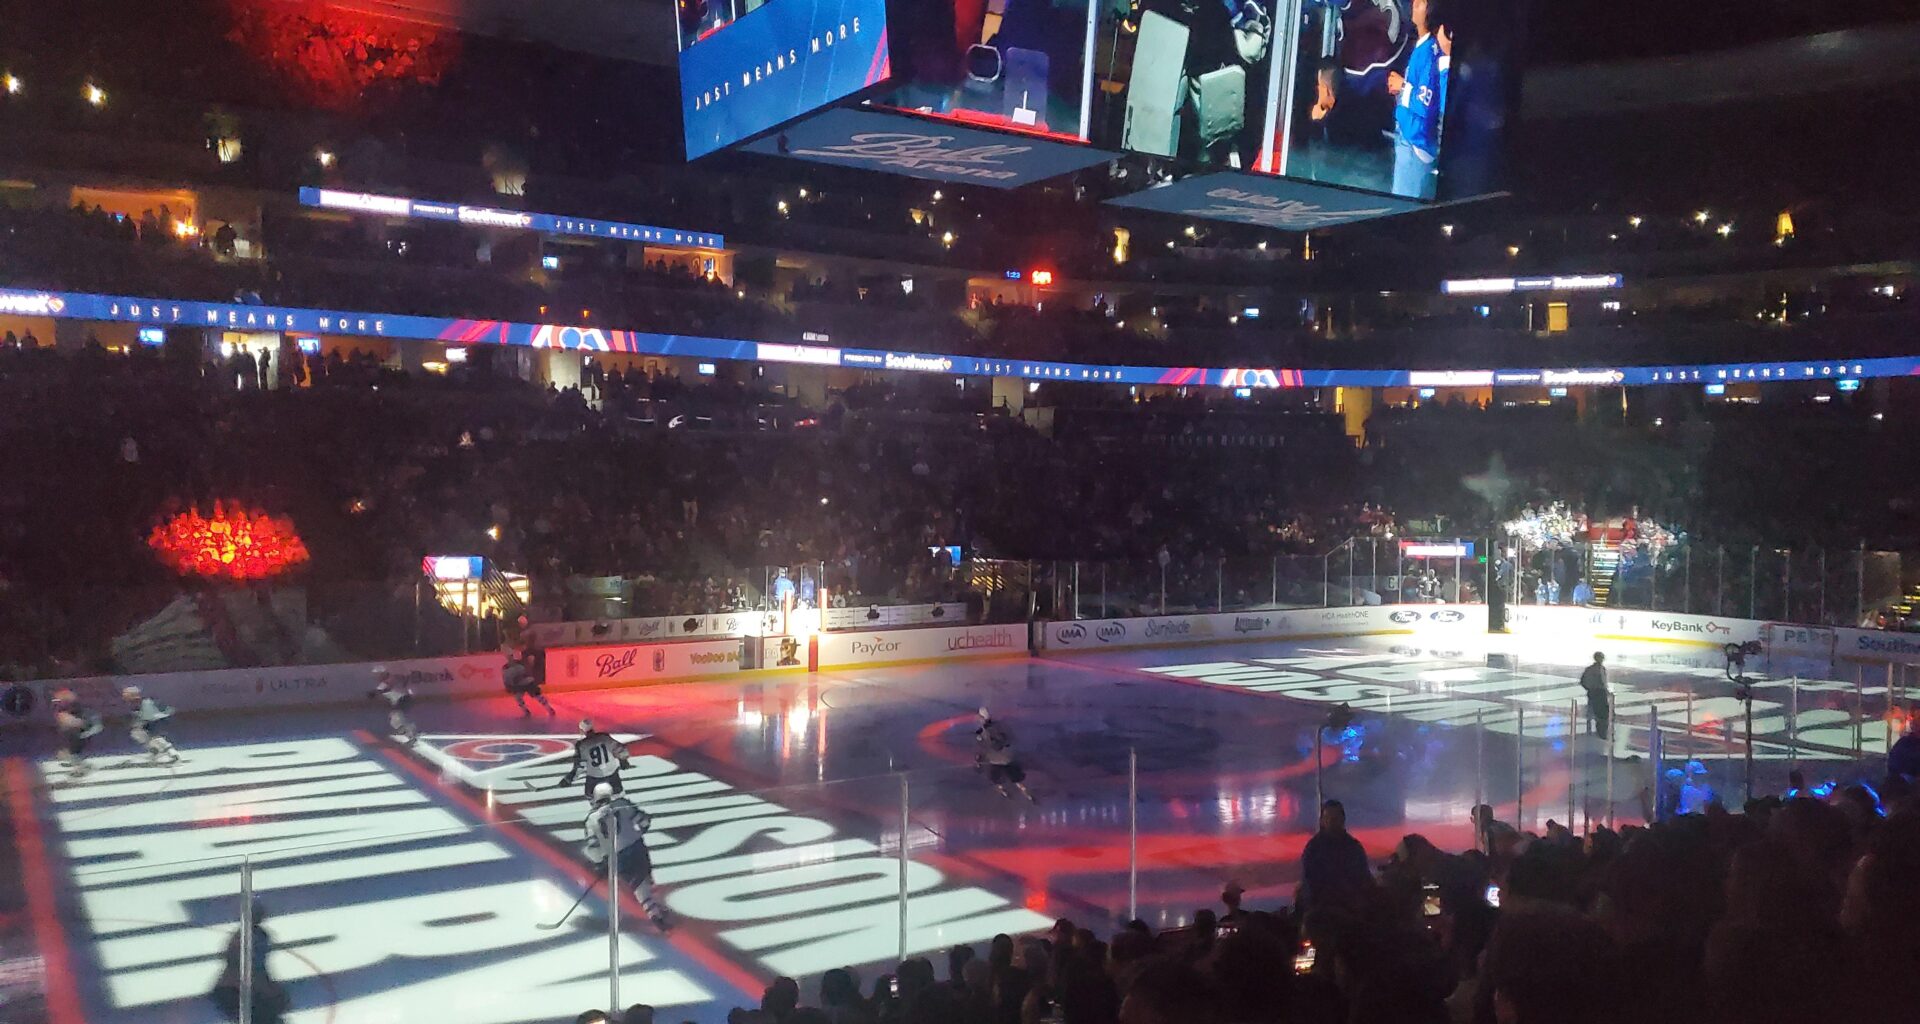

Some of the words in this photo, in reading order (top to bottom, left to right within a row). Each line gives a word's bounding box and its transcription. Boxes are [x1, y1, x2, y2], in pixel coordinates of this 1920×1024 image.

[695, 80, 731, 111] JUST
[743, 48, 798, 89] MEANS
[812, 16, 861, 54] MORE
[556, 220, 596, 232] JUST
[610, 226, 662, 240] MEANS
[675, 233, 714, 246] MORE
[110, 303, 182, 319] JUST
[207, 310, 294, 327] MEANS
[318, 317, 384, 332] MORE
[885, 351, 945, 371] Southwest
[975, 362, 1011, 374] JUST
[1023, 365, 1071, 377] MEANS
[1082, 369, 1123, 379] MORE
[1652, 370, 1700, 381] JUST
[1718, 367, 1786, 379] MEANS
[1805, 365, 1863, 376] MORE
[1061, 629, 1082, 639] IMA
[1101, 627, 1121, 638] IMA
[1651, 619, 1704, 633] KeyBank
[851, 640, 901, 657] Paycor
[947, 628, 1012, 651] uchealth
[595, 648, 638, 678] Ball
[589, 743, 609, 768] 91
